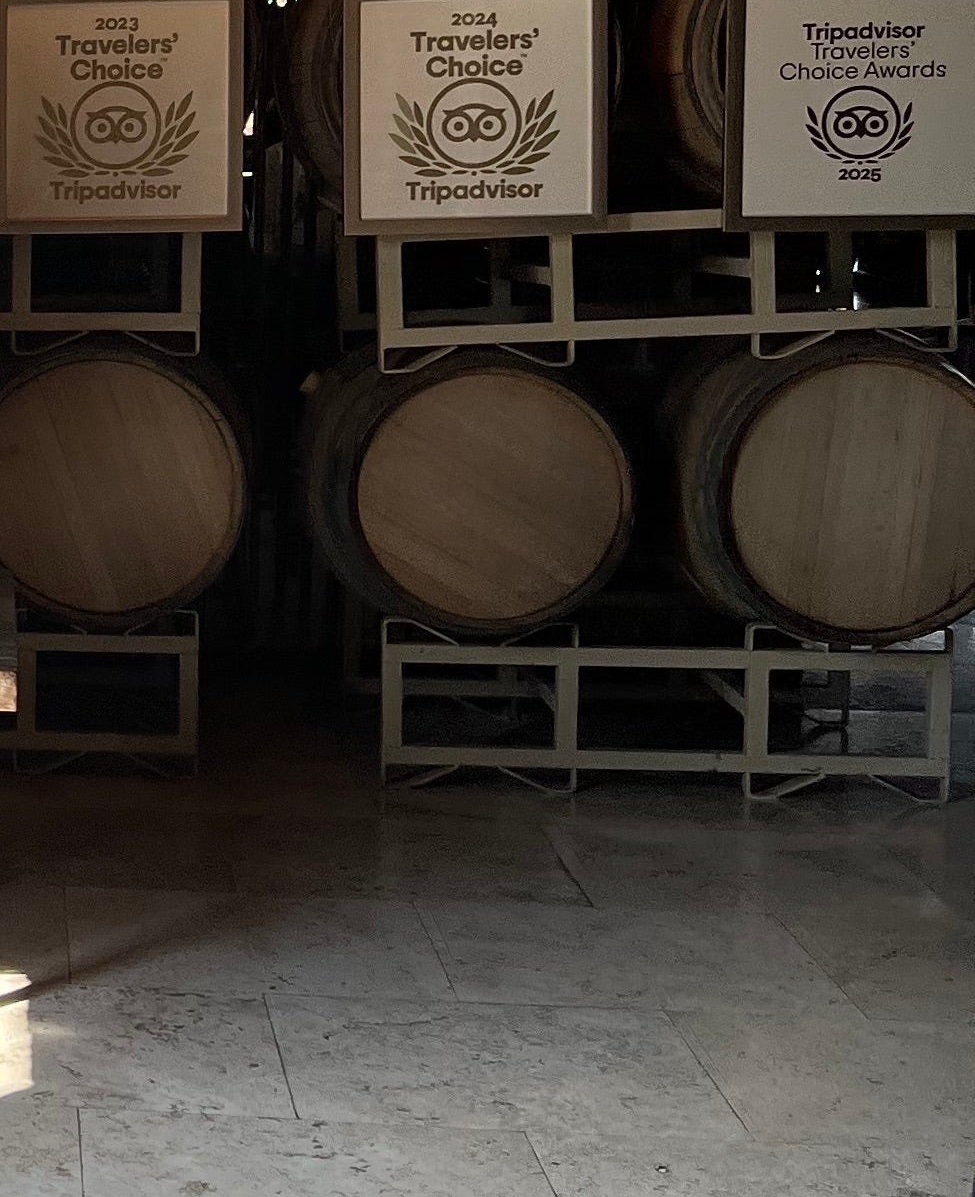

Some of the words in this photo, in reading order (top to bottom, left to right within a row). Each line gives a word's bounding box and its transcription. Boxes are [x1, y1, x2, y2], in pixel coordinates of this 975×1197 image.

[94, 17, 139, 32] 2023
[451, 12, 498, 28] 2024
[802, 21, 925, 44] Tripadvisor
[780, 62, 859, 81] Choice
[863, 60, 947, 79] Awards
[838, 167, 882, 183] 2025
[50, 180, 181, 205] Tripadvisor
[405, 178, 543, 205] Tripadvisor
